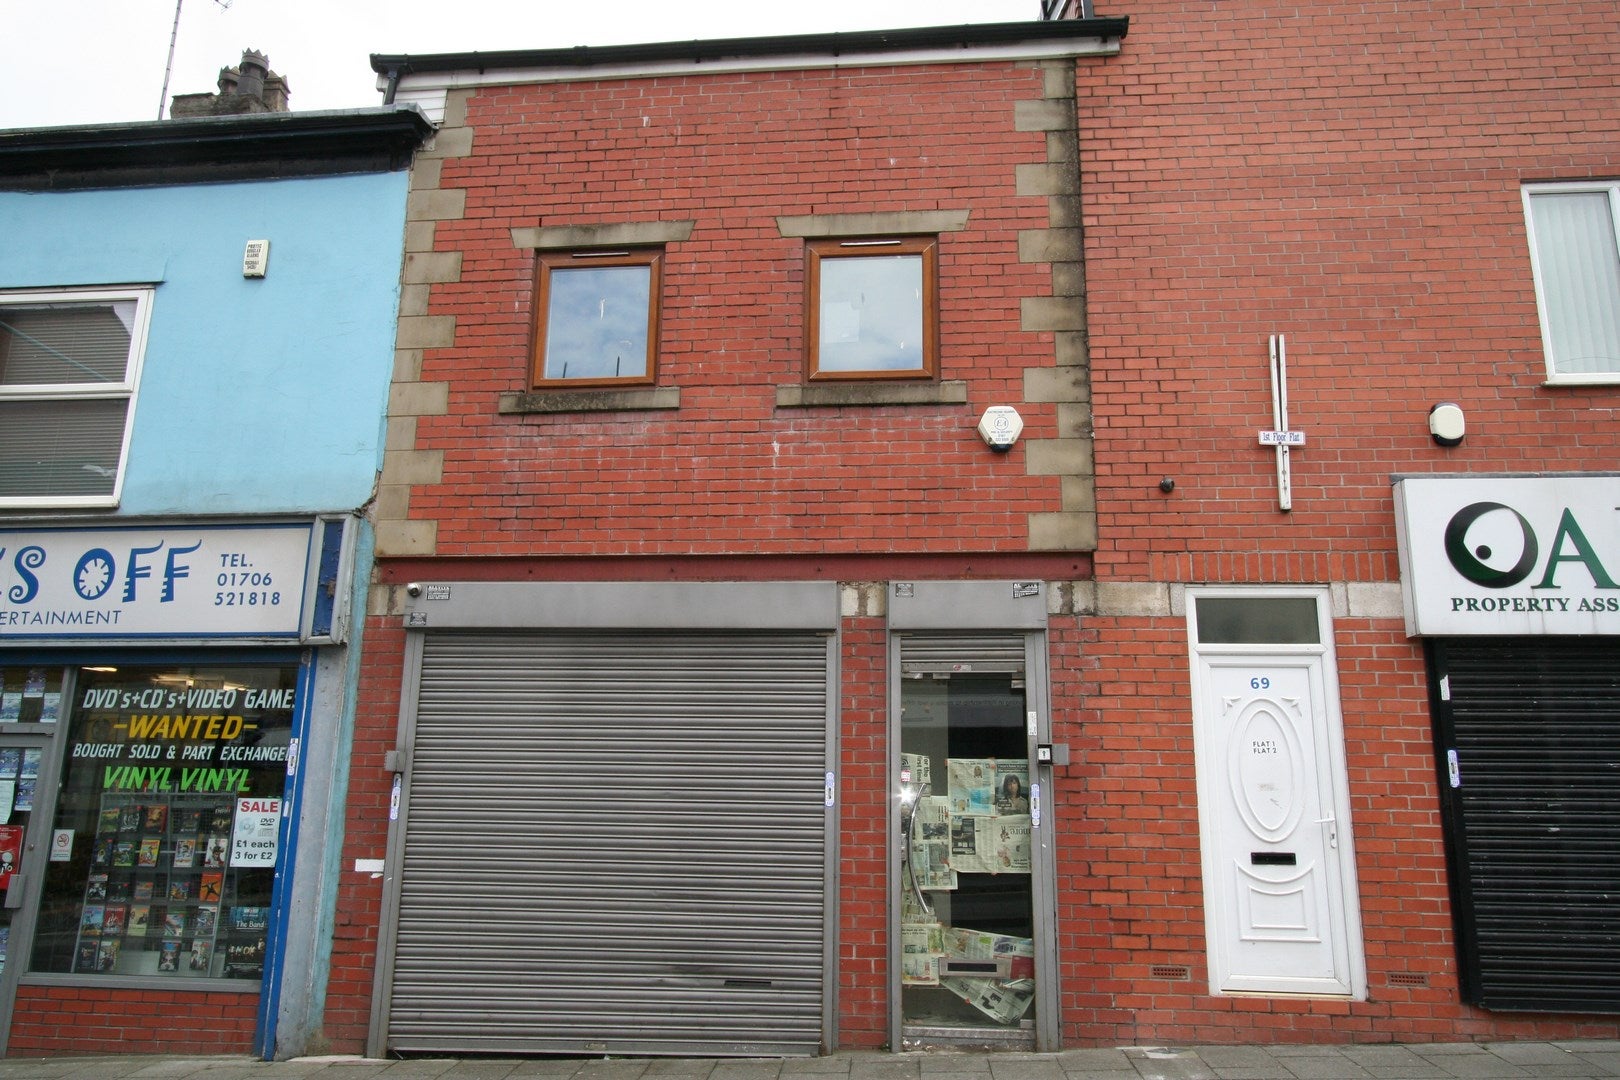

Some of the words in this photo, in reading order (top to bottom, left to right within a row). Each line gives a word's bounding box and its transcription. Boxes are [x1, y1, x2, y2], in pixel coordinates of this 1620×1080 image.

[1262, 432, 1271, 441] 1st
[1272, 432, 1287, 442] Floor
[1289, 432, 1300, 442] Flat
[1444, 501, 1620, 590] OA
[220, 553, 254, 568] TEL.
[0, 545, 47, 604] S
[73, 539, 203, 603] OFF
[217, 572, 273, 587] 01706
[214, 591, 281, 606] 521818
[1451, 597, 1570, 612] PROPERTY
[1577, 597, 1619, 612] ASS
[1250, 677, 1270, 690] 69
[72, 742, 125, 759] BOUGHT
[128, 744, 161, 760] SOLD
[166, 744, 176, 759] &
[182, 745, 215, 761] PART
[103, 765, 172, 790] VINYL
[180, 767, 251, 792] VINYL
[240, 800, 279, 813] SALE
[236, 840, 249, 849] £1
[250, 840, 275, 849] each
[235, 851, 241, 860] 3
[243, 851, 258, 860] for
[260, 851, 273, 860] £2
[236, 920, 247, 928] The
[248, 920, 265, 928] Band
